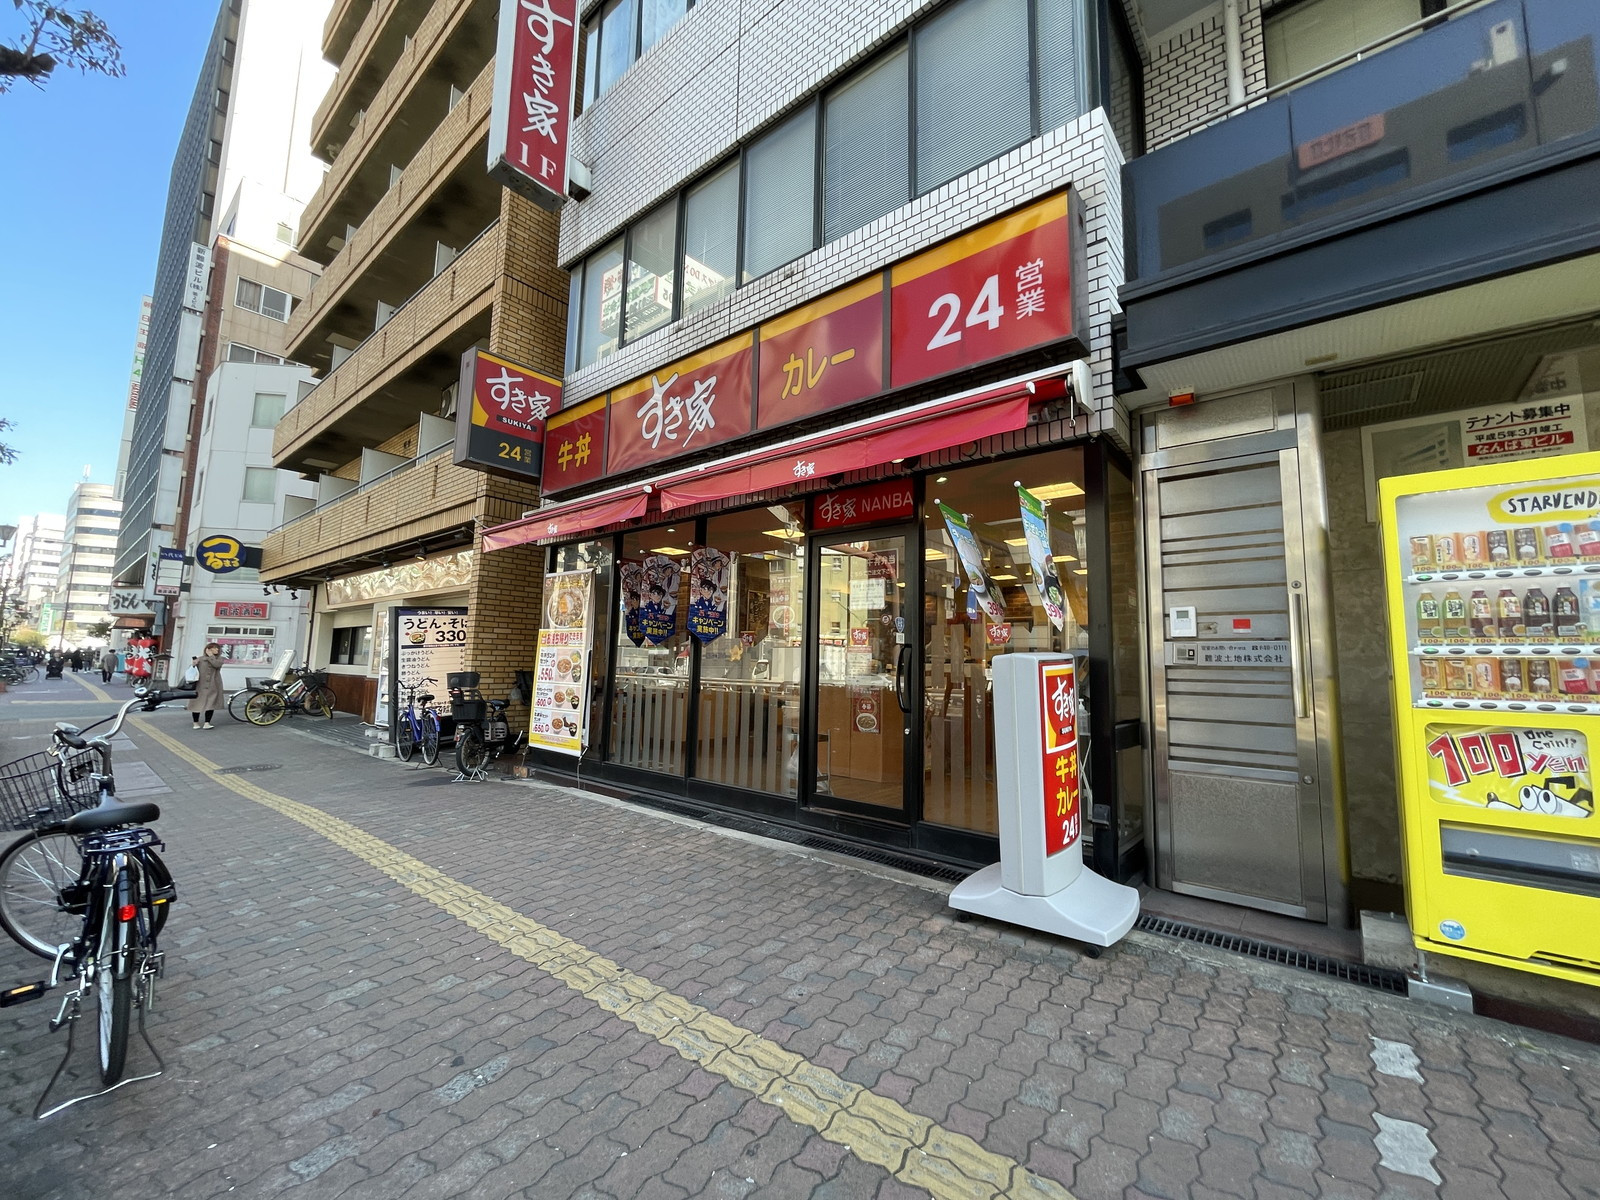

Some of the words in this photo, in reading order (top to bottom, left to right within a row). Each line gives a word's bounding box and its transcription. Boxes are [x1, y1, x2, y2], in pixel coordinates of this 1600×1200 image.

[520, 0, 574, 144] すき家
[927, 274, 1004, 351] 24
[1014, 258, 1046, 320] 営業
[781, 347, 856, 400] カレー
[486, 367, 551, 423] すき家
[637, 372, 718, 449] すき家
[501, 416, 532, 431] SUKIYA
[1466, 403, 1571, 430] テナント募集中
[1475, 423, 1563, 441] 平成5年3月竣工
[498, 442, 522, 462] 24
[557, 432, 592, 472] 牛丼
[1476, 435, 1565, 455] なんば東ビル
[793, 460, 815, 478] すき家
[819, 494, 857, 523] すき家
[861, 491, 914, 513] NANBA
[1508, 490, 1600, 513] STARVEND
[435, 630, 467, 642] 330
[692, 616, 724, 627] キャンペーン
[1052, 676, 1075, 724] すき家
[1055, 751, 1077, 784] 牛丼
[1427, 731, 1528, 787] 100
[1056, 787, 1079, 818] カレー
[1062, 815, 1075, 845] 24
